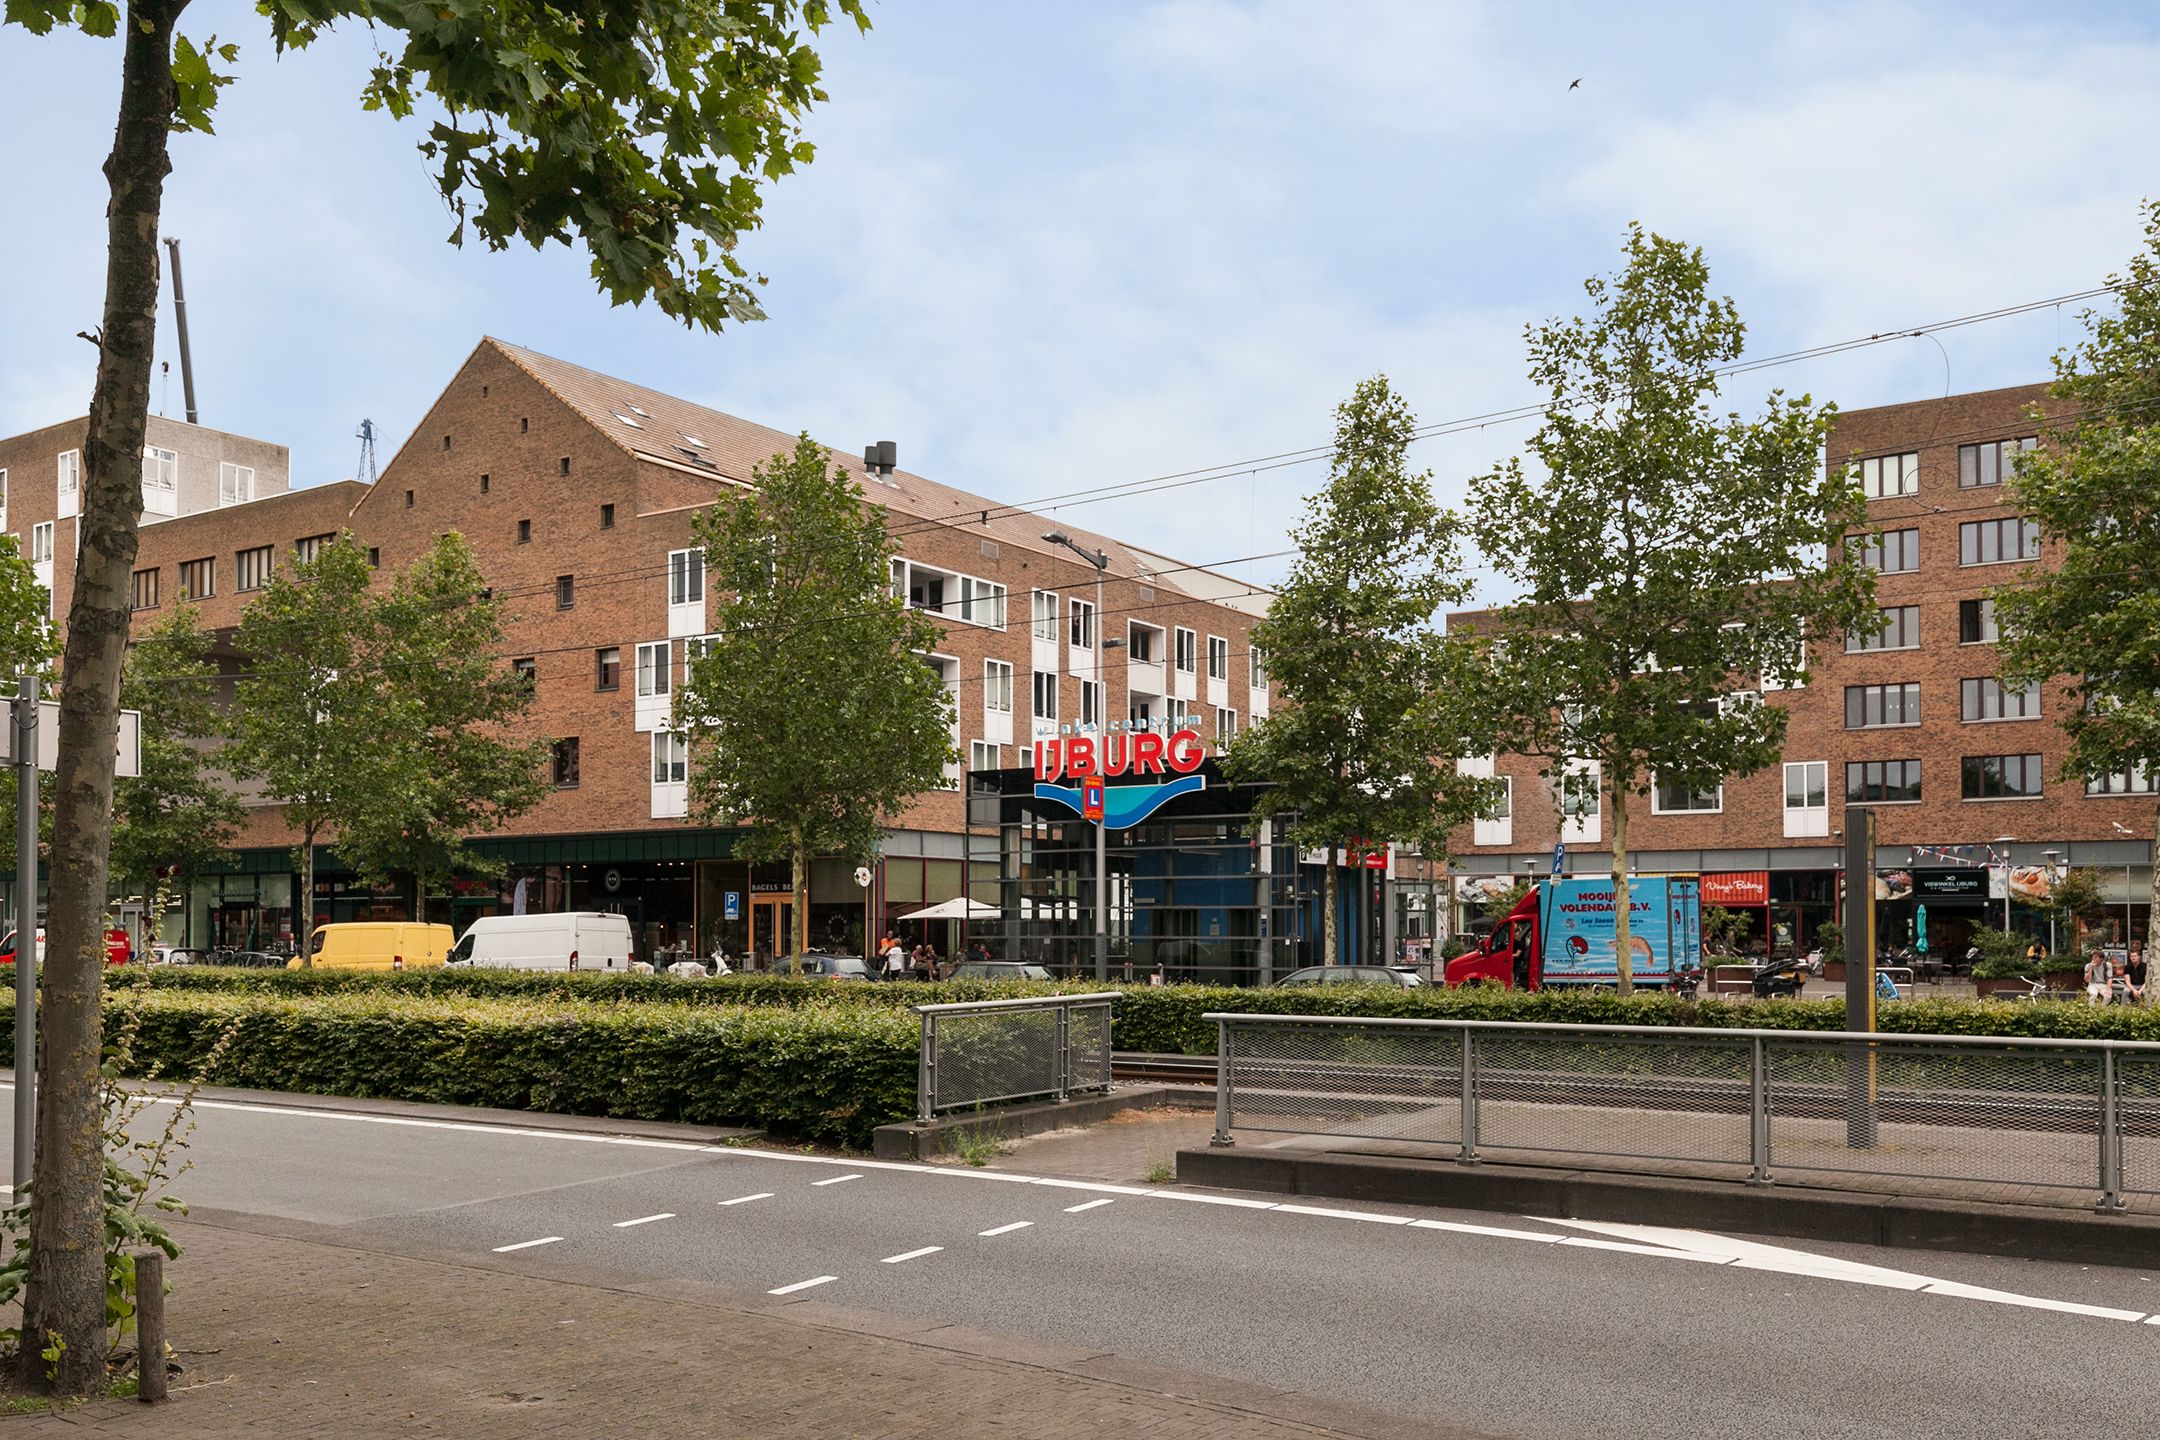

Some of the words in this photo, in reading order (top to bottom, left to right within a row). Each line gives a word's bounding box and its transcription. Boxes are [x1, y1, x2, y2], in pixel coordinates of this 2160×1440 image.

[1035, 714, 1202, 736] wnkecentrum
[1034, 729, 1206, 783] IJBURG
[1091, 789, 1099, 805] L
[1557, 846, 1563, 862] P
[1733, 880, 1764, 894] Bakery
[728, 894, 736, 906] P
[1560, 902, 1616, 913] VOLENDA
